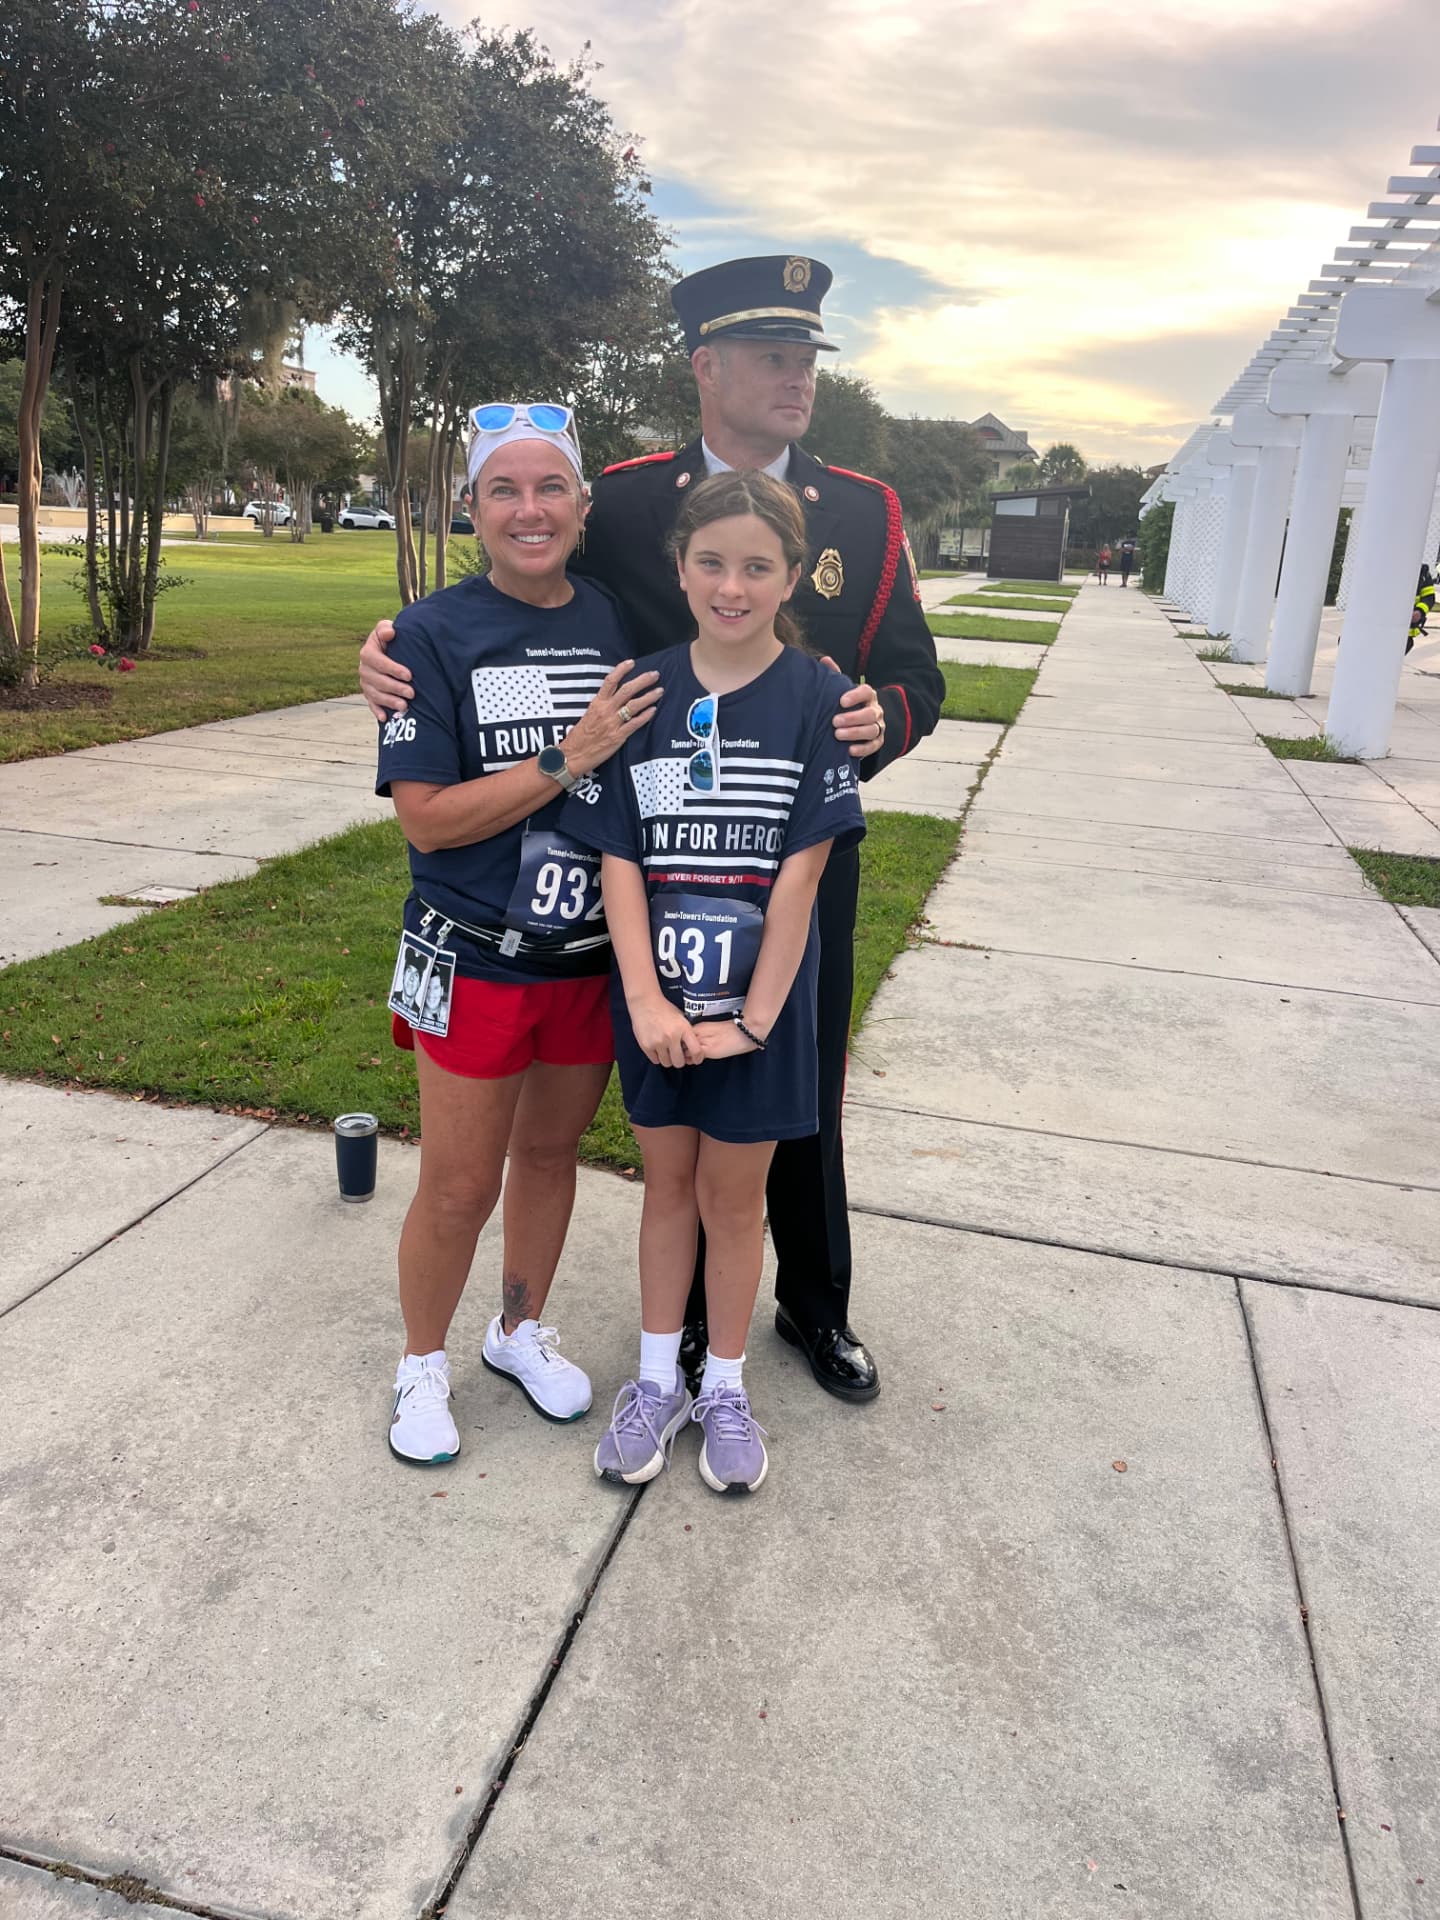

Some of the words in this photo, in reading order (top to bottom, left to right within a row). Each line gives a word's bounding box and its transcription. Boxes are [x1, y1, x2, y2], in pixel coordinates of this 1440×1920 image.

[479, 731, 487, 757] I
[495, 726, 545, 757] RUN
[721, 738, 760, 749] Foundation
[675, 823, 717, 850] FOR
[531, 862, 605, 921] 932
[693, 873, 727, 884] FORGET
[680, 911, 702, 921] Towers
[702, 913, 738, 924] Foundation
[658, 926, 732, 985] 931
